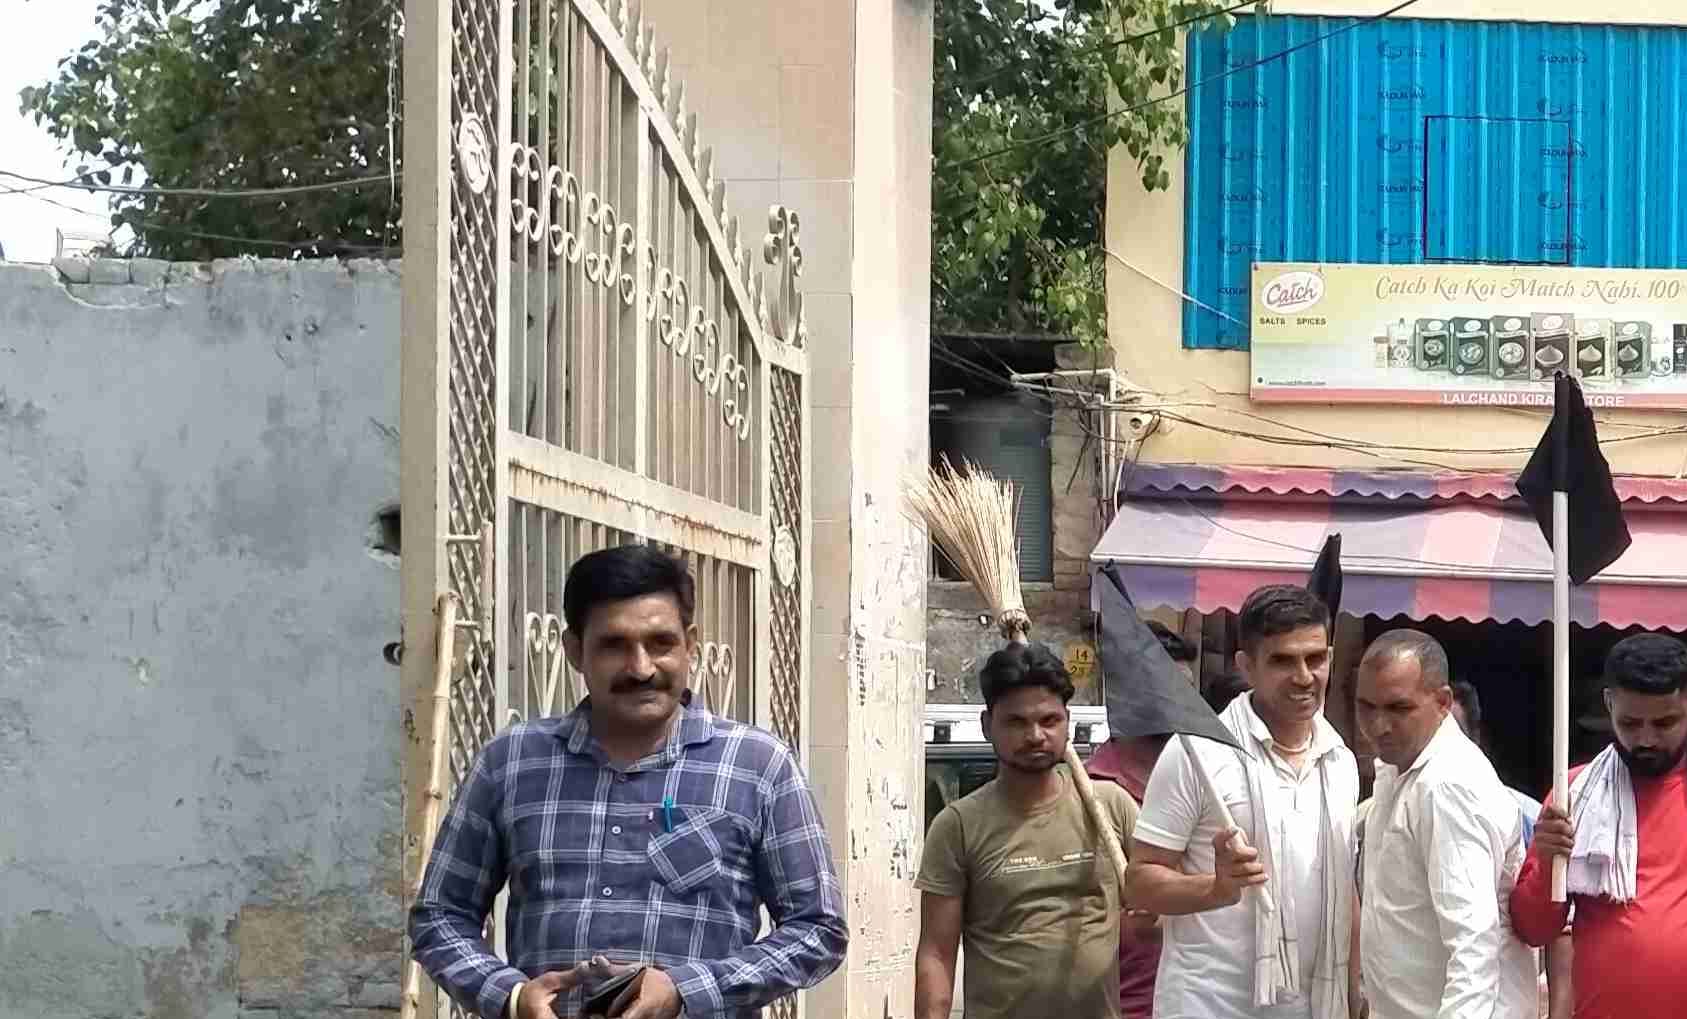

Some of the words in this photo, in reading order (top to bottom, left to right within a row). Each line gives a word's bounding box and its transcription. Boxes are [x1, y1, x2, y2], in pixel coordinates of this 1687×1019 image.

[1266, 276, 1318, 307] Catch
[1376, 276, 1427, 299] Catch
[1433, 277, 1460, 301] Ka
[1464, 278, 1496, 302] Koi
[1500, 277, 1574, 299] Match
[1296, 317, 1327, 326] SPICES
[1441, 392, 1518, 405] LALCHAND
[1521, 394, 1556, 406] KIRA
[1587, 395, 1625, 408] TORE
